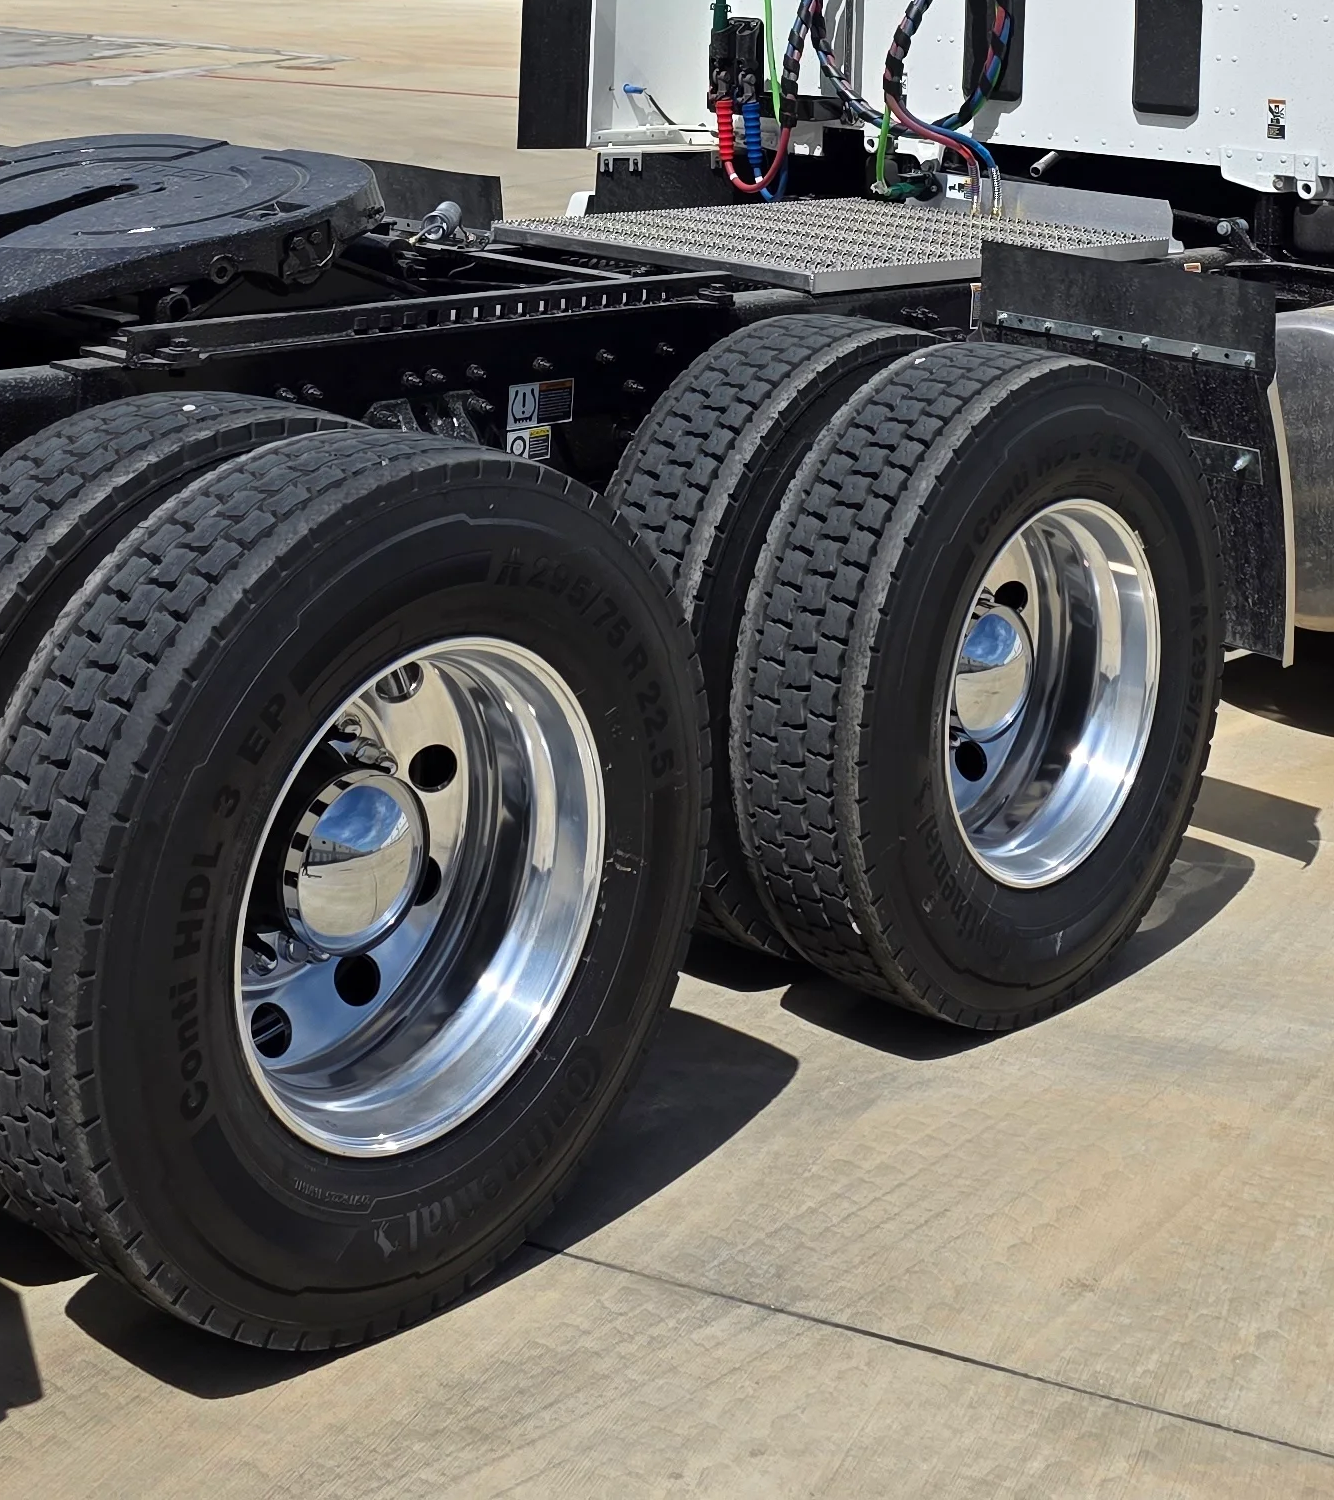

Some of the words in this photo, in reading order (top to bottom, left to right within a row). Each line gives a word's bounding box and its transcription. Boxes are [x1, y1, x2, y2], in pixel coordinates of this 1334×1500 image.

[526, 555, 634, 650] 295/75
[622, 642, 649, 682] R
[636, 680, 675, 779] 22.5
[237, 691, 287, 766] EP
[212, 784, 242, 820] 3
[173, 840, 223, 960] HDL
[170, 975, 210, 1123] Conti
